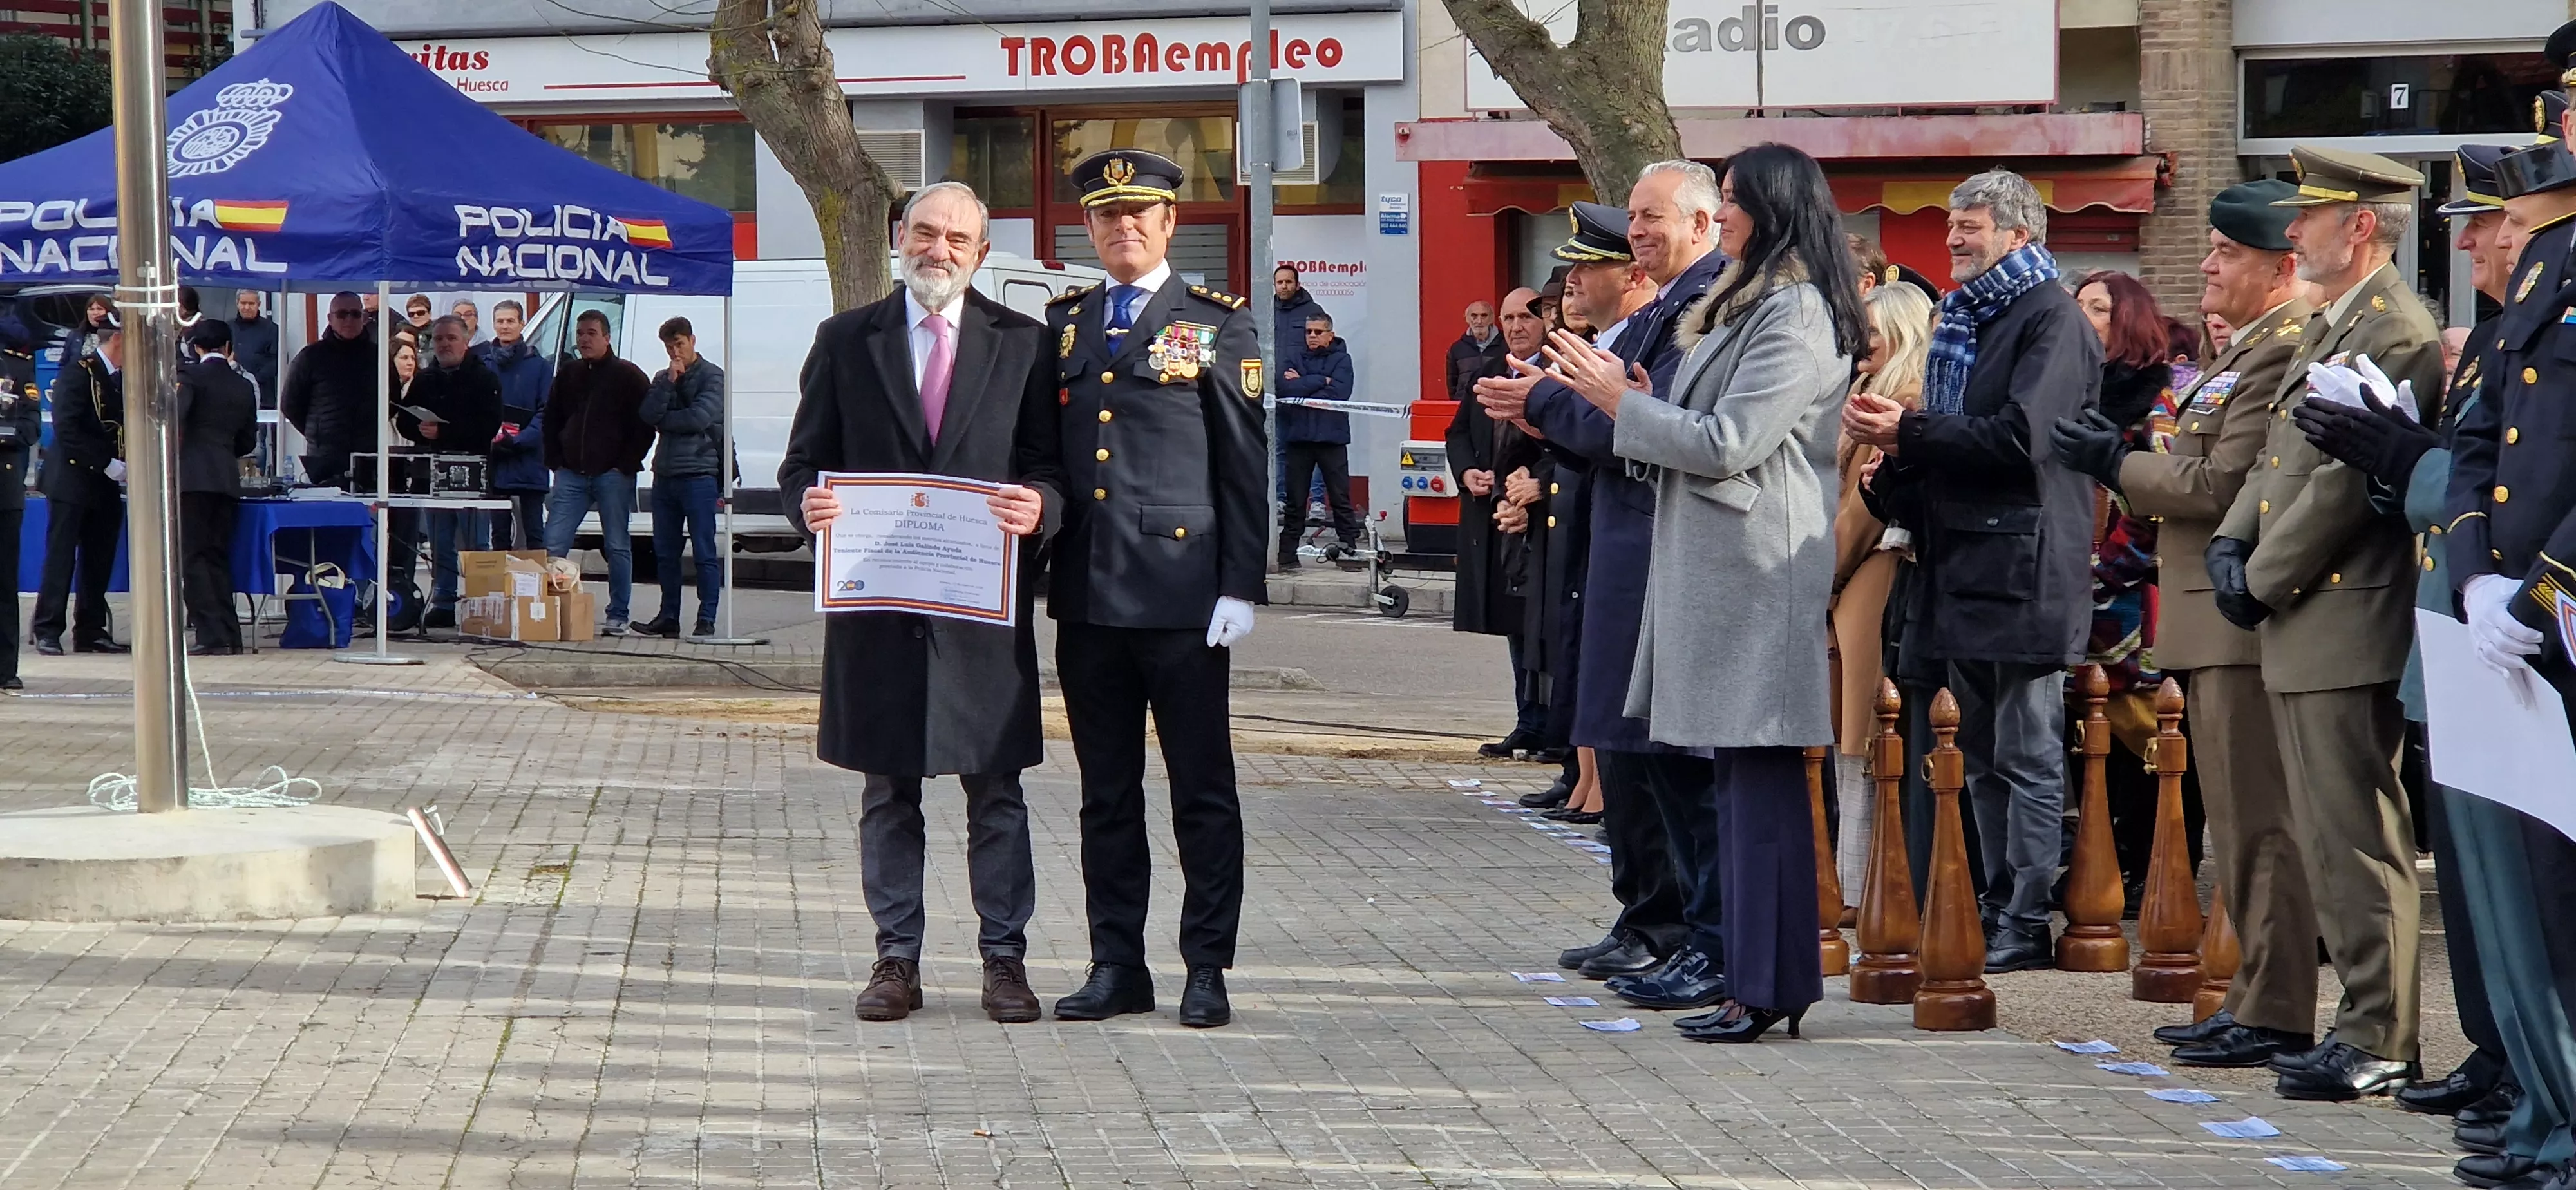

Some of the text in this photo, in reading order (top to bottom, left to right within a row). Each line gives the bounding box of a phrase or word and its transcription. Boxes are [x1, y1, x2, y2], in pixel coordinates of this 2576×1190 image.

[1663, 5, 1826, 52] adio
[411, 44, 489, 71] itas
[457, 77, 509, 92] Huesca
[2394, 86, 2407, 106] 7
[0, 235, 287, 273] NACINAL
[455, 244, 670, 287] NACIONAL
[895, 519, 945, 532] DIPLOMA
[906, 509, 945, 520] Provincial
[959, 515, 988, 525] Huesca
[936, 552, 968, 562] Provincial
[978, 558, 1001, 567] Huesca
